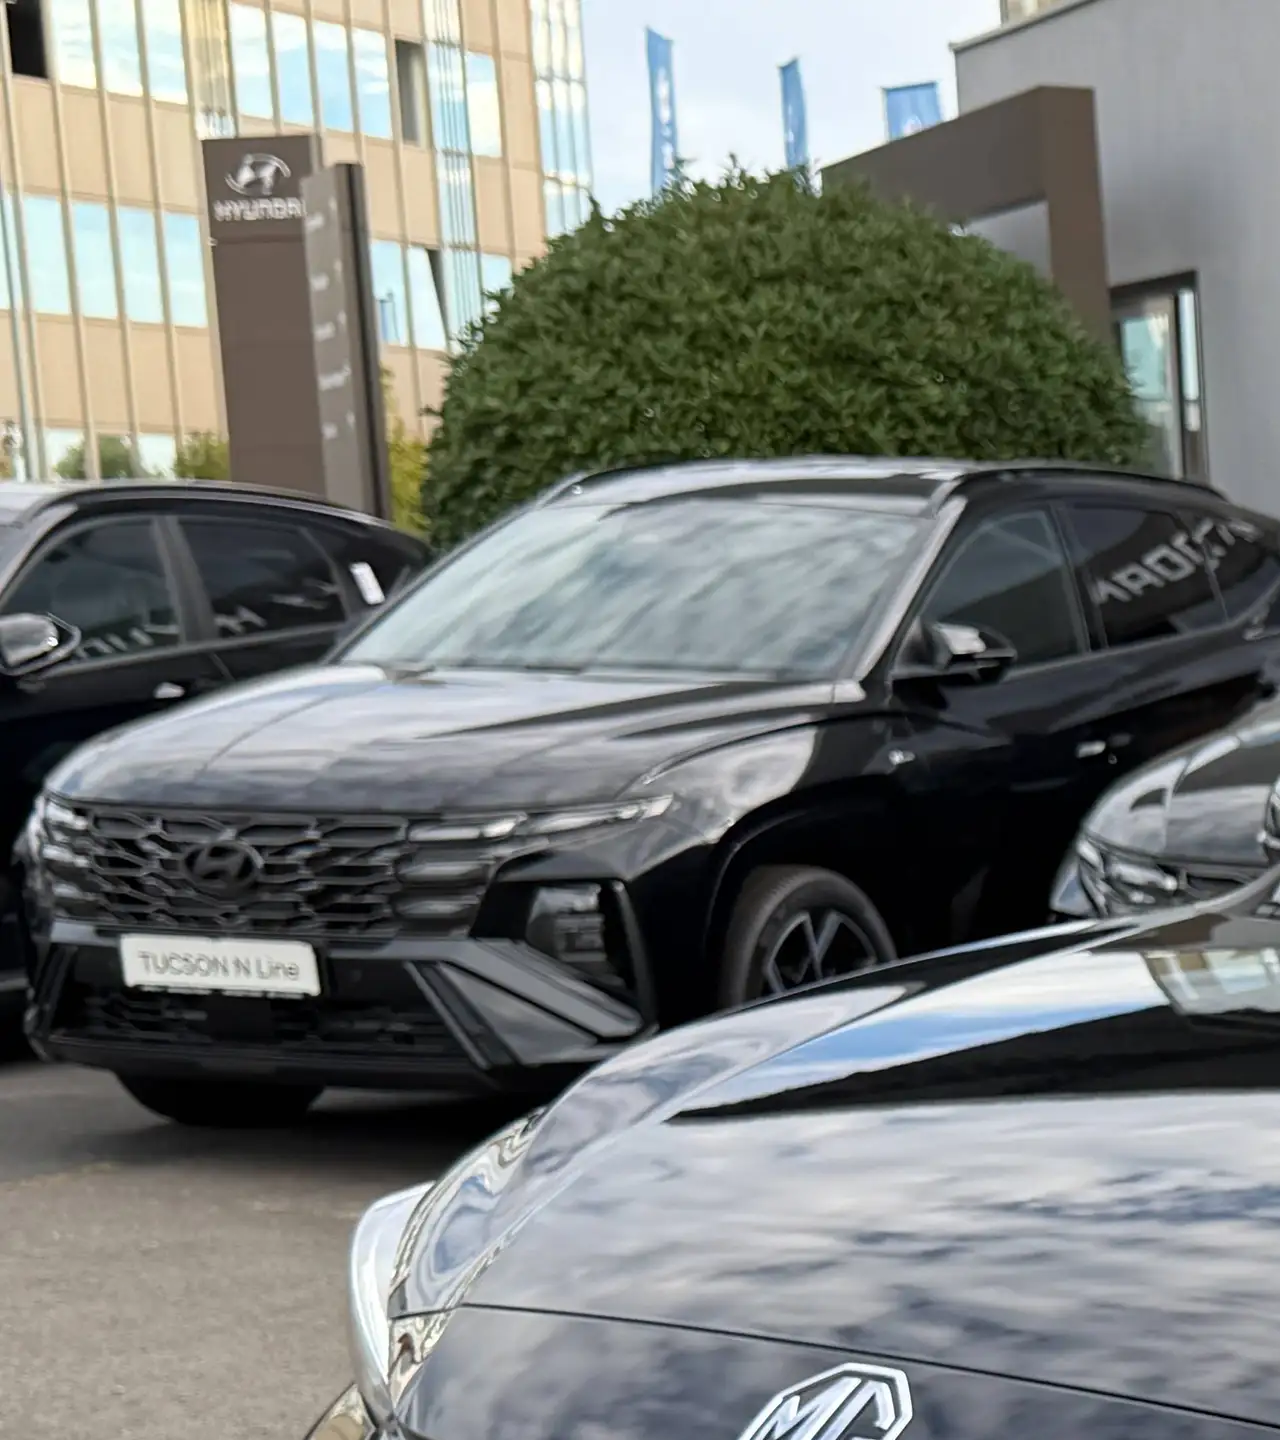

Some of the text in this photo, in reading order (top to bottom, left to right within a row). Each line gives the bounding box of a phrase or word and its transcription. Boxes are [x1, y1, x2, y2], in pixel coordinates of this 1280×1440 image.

[137, 951, 300, 981] TUCSON N Line
